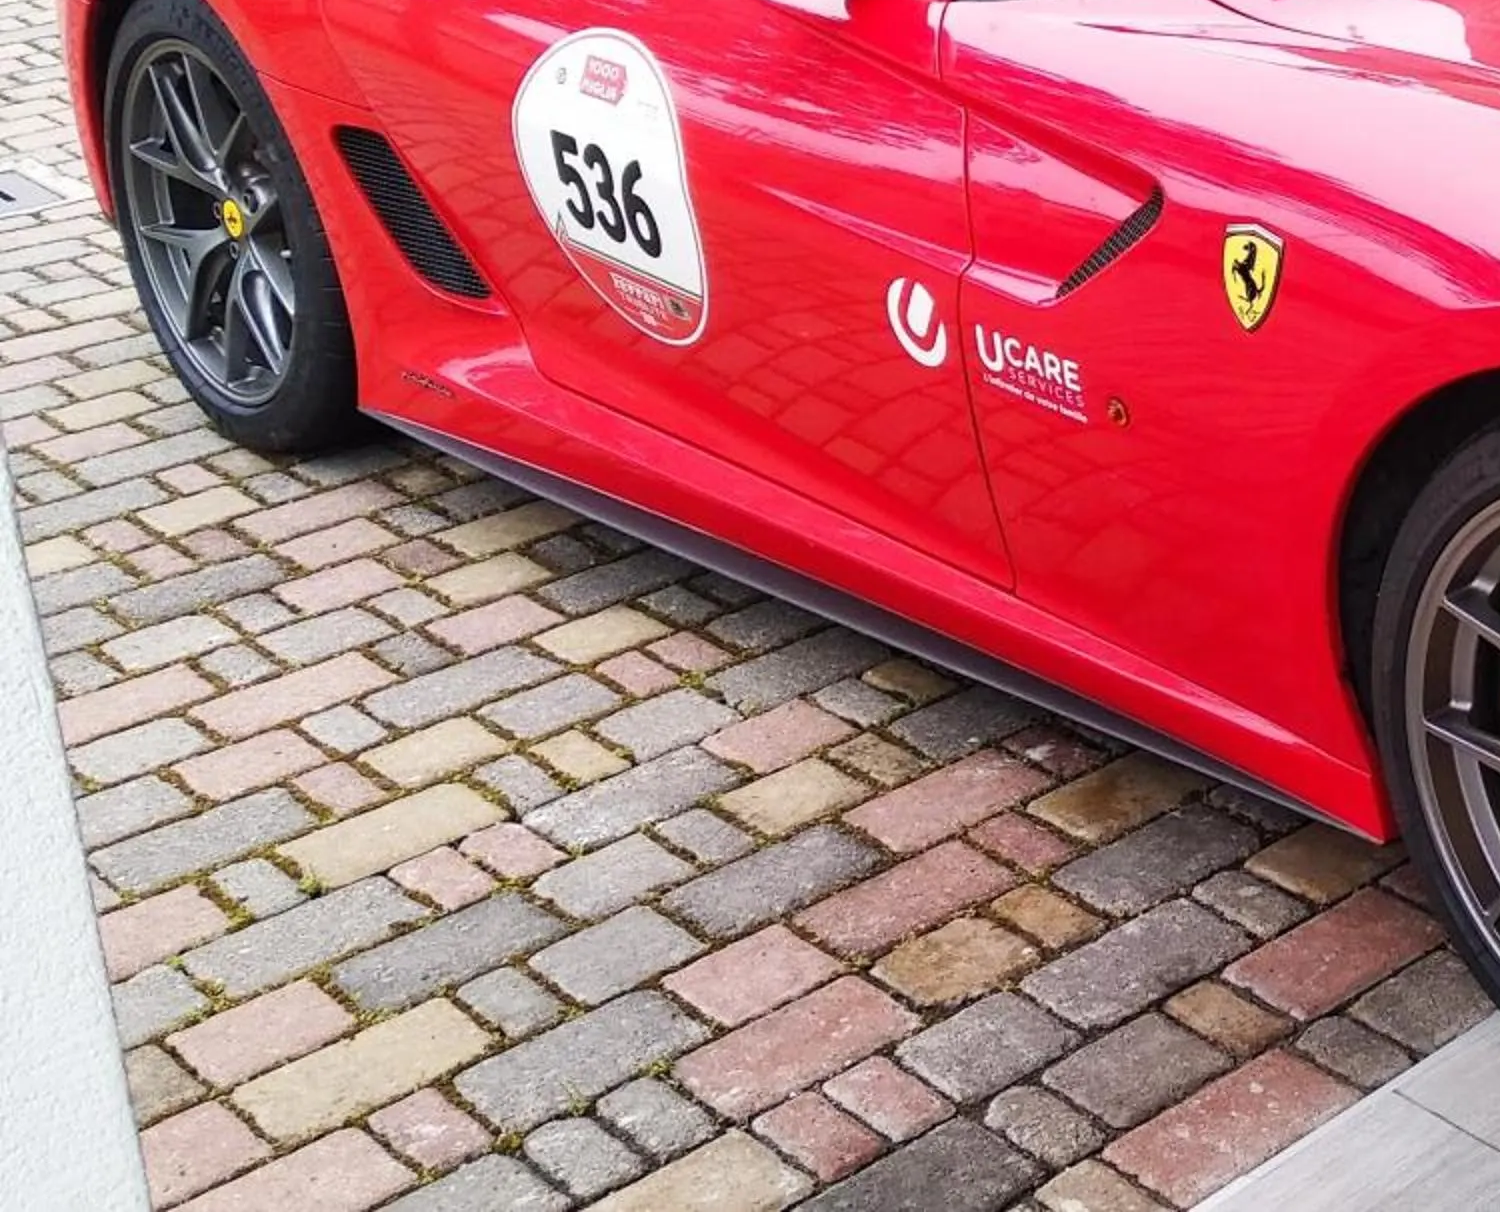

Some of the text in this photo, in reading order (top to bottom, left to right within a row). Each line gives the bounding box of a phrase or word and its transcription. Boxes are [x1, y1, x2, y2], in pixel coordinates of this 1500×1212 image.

[550, 129, 662, 258] 536
[975, 324, 1081, 391] UCARE
[1008, 367, 1086, 408] SERVICES
